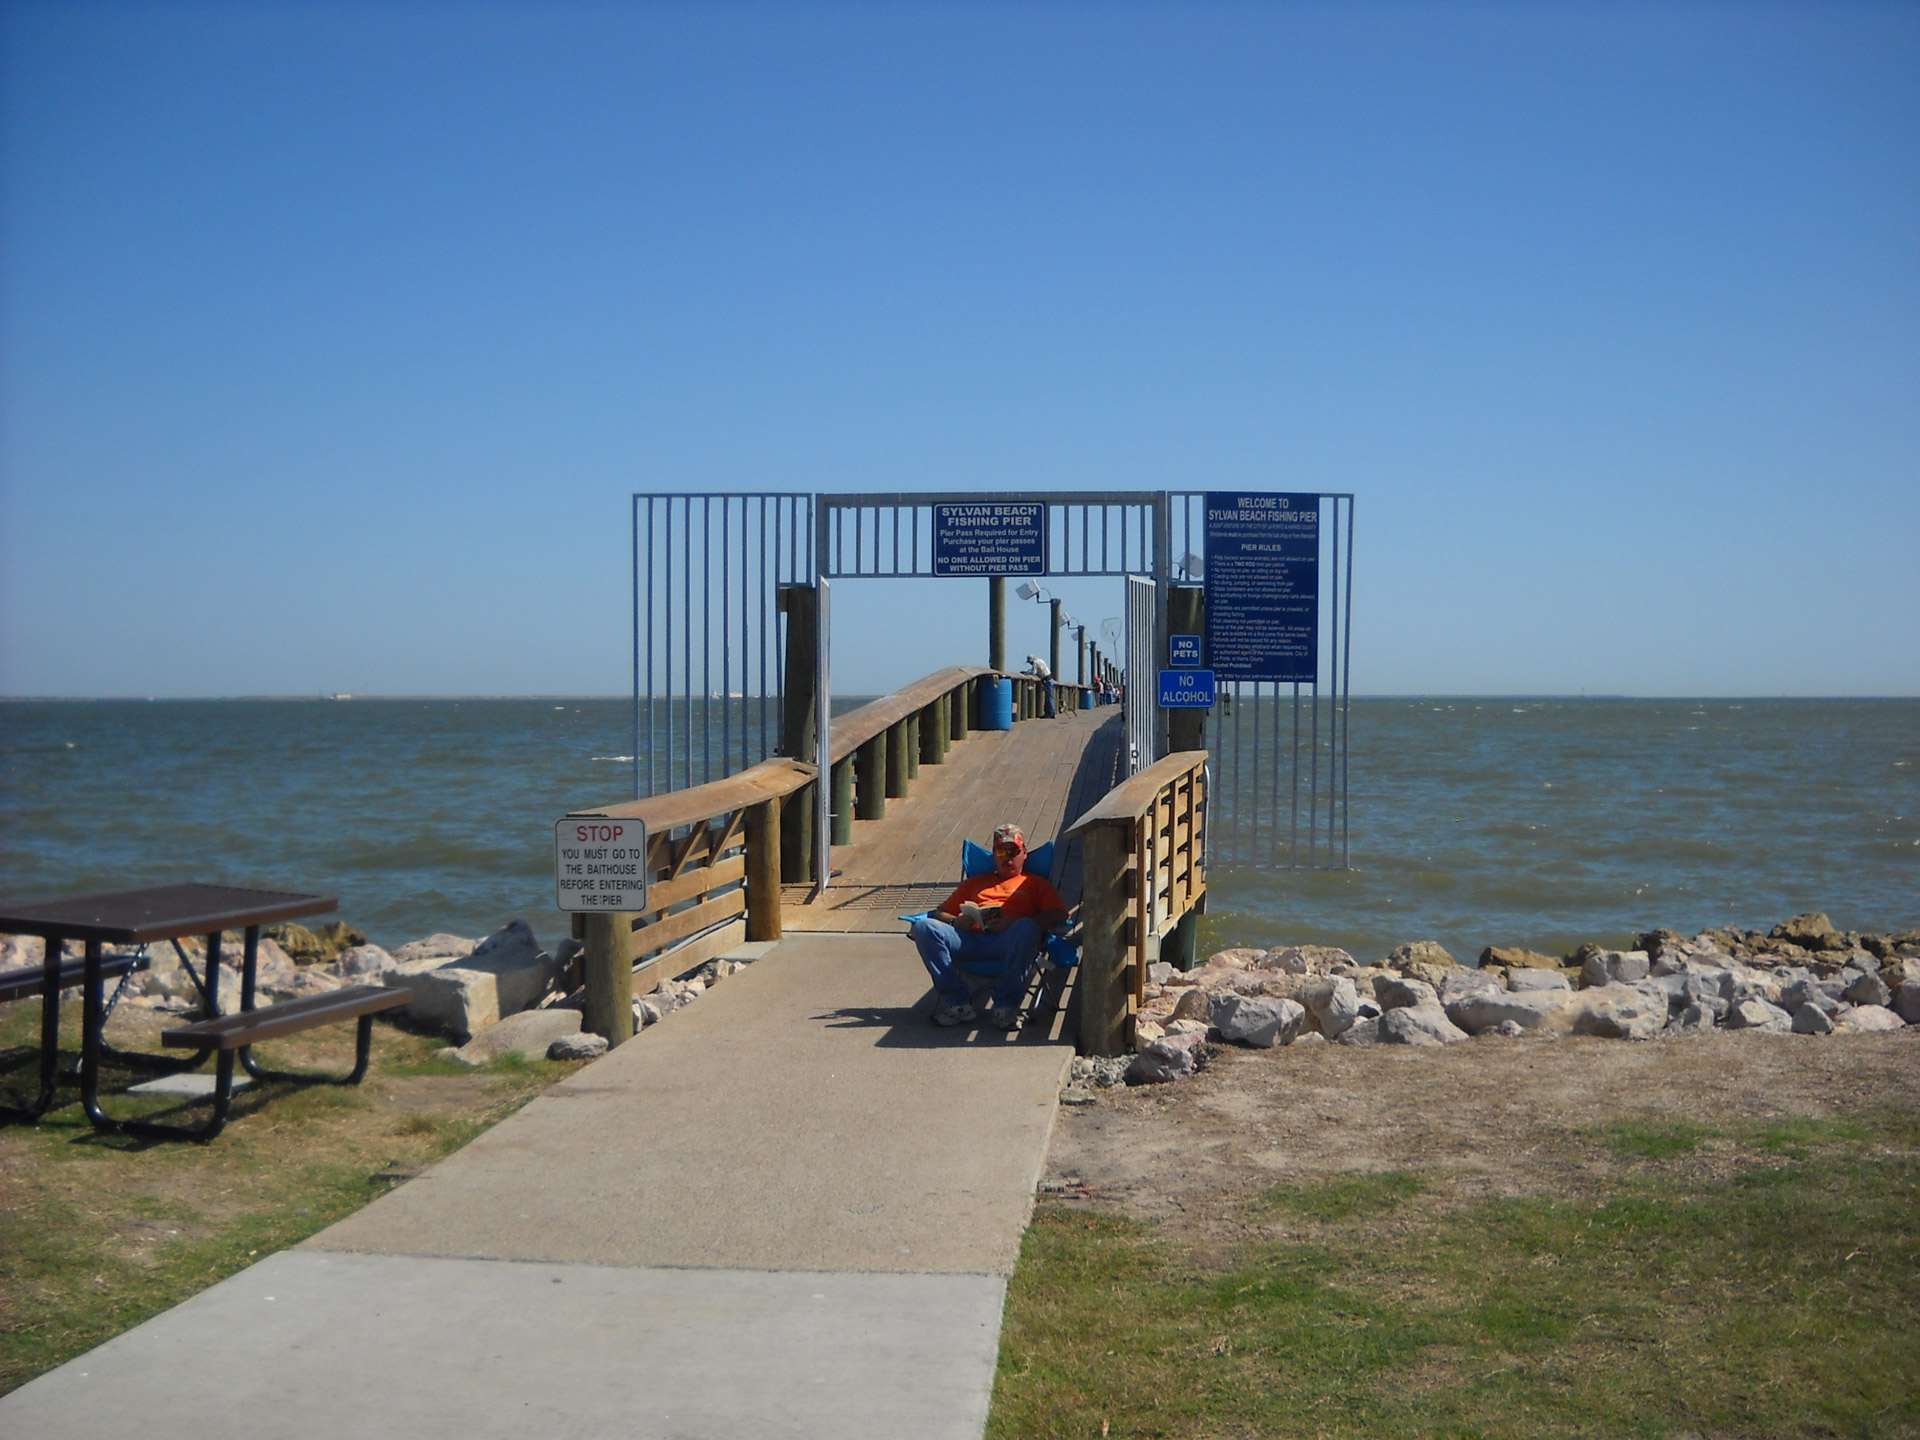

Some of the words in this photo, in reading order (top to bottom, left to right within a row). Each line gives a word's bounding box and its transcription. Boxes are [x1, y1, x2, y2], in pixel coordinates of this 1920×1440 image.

[1238, 498, 1276, 508] WELCOME
[1278, 498, 1289, 508] TO
[942, 507, 990, 516] SYLVAN
[995, 507, 1037, 515] BEACH
[1209, 510, 1238, 520] SYLVAN
[1240, 511, 1266, 521] BEACH
[1268, 511, 1298, 521] FISHING
[1300, 512, 1317, 522] PIER
[948, 518, 999, 526] FISHING
[1003, 517, 1031, 525] PIER
[975, 529, 1006, 537] Required
[1020, 529, 1038, 537] Entry
[1173, 650, 1198, 658] PETS
[1179, 676, 1194, 686] NO
[1163, 692, 1211, 702] ALCOHOL
[577, 826, 623, 841] STOP
[562, 849, 579, 859] YOU
[584, 849, 608, 859] MUST
[613, 849, 625, 859] GO
[629, 849, 640, 859] TO
[566, 864, 582, 874] THE
[588, 864, 636, 874] BAITHOUSE
[560, 880, 594, 889] BEFORE
[600, 880, 642, 890] ENTERING
[581, 895, 597, 905] THE
[602, 895, 622, 905] PIER
